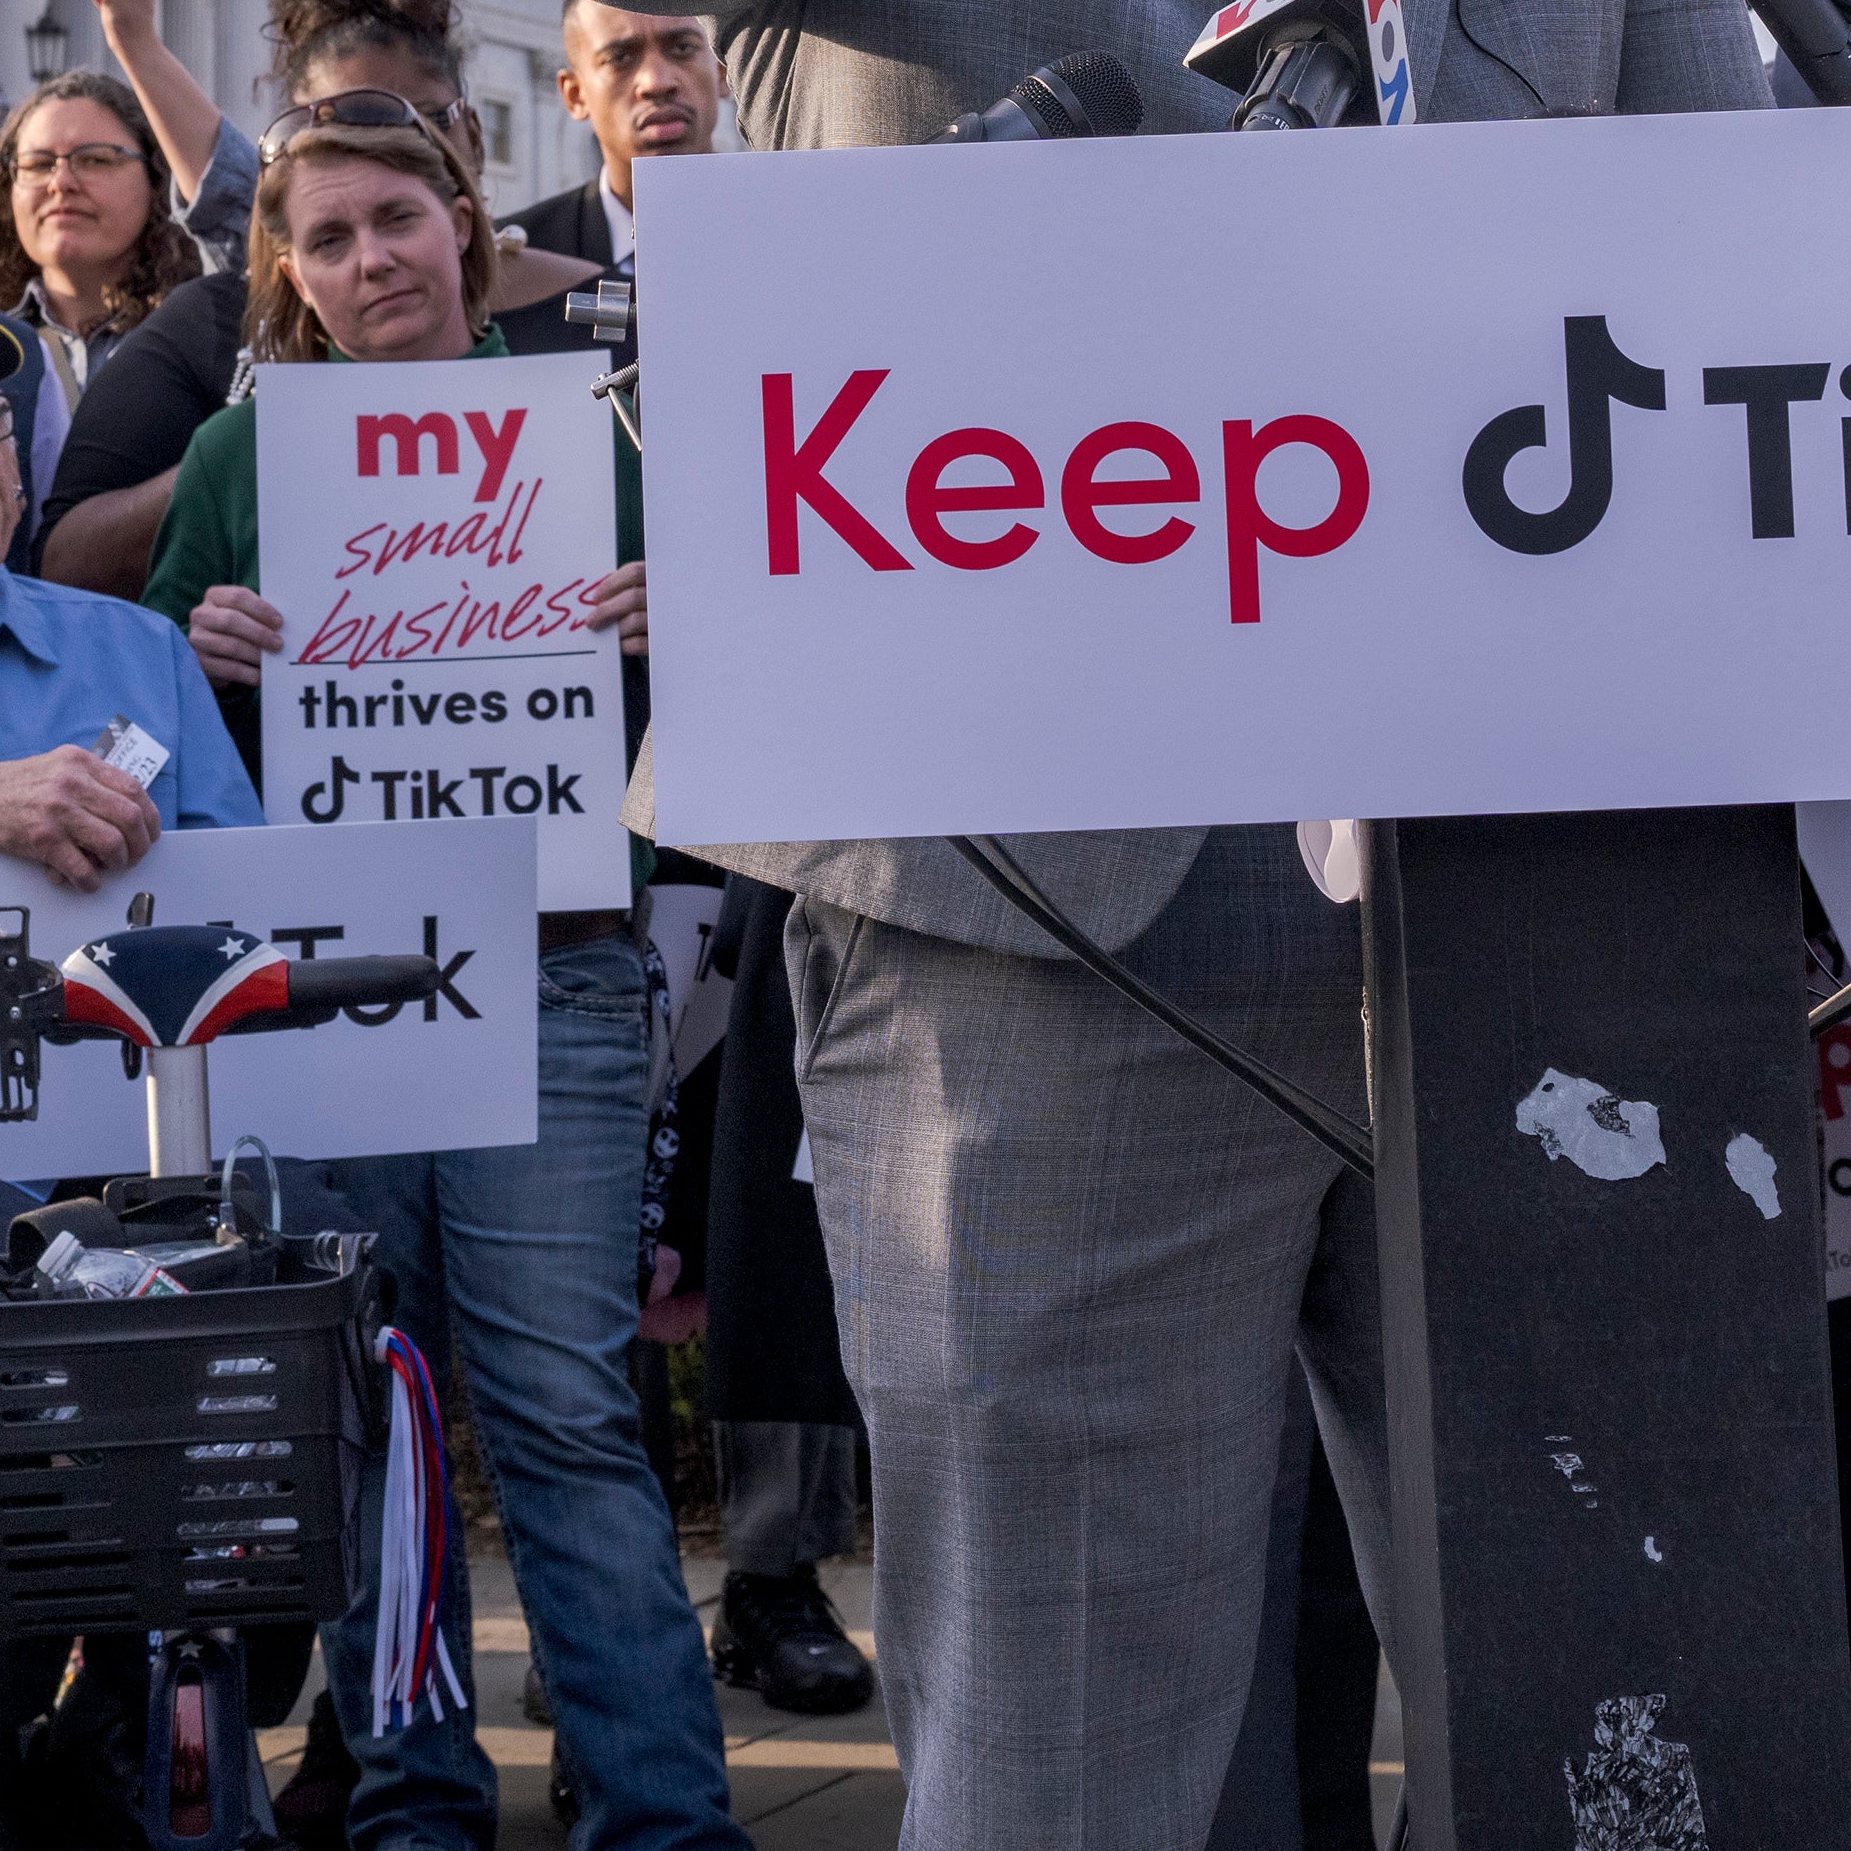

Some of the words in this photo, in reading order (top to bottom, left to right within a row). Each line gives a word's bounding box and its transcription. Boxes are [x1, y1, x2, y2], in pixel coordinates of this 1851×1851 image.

[355, 407, 528, 503] my
[760, 368, 1371, 625] Keep
[336, 478, 543, 580] small
[297, 572, 613, 671] business
[298, 679, 508, 729] thrives
[527, 686, 595, 721] on
[371, 764, 586, 821] TikTok
